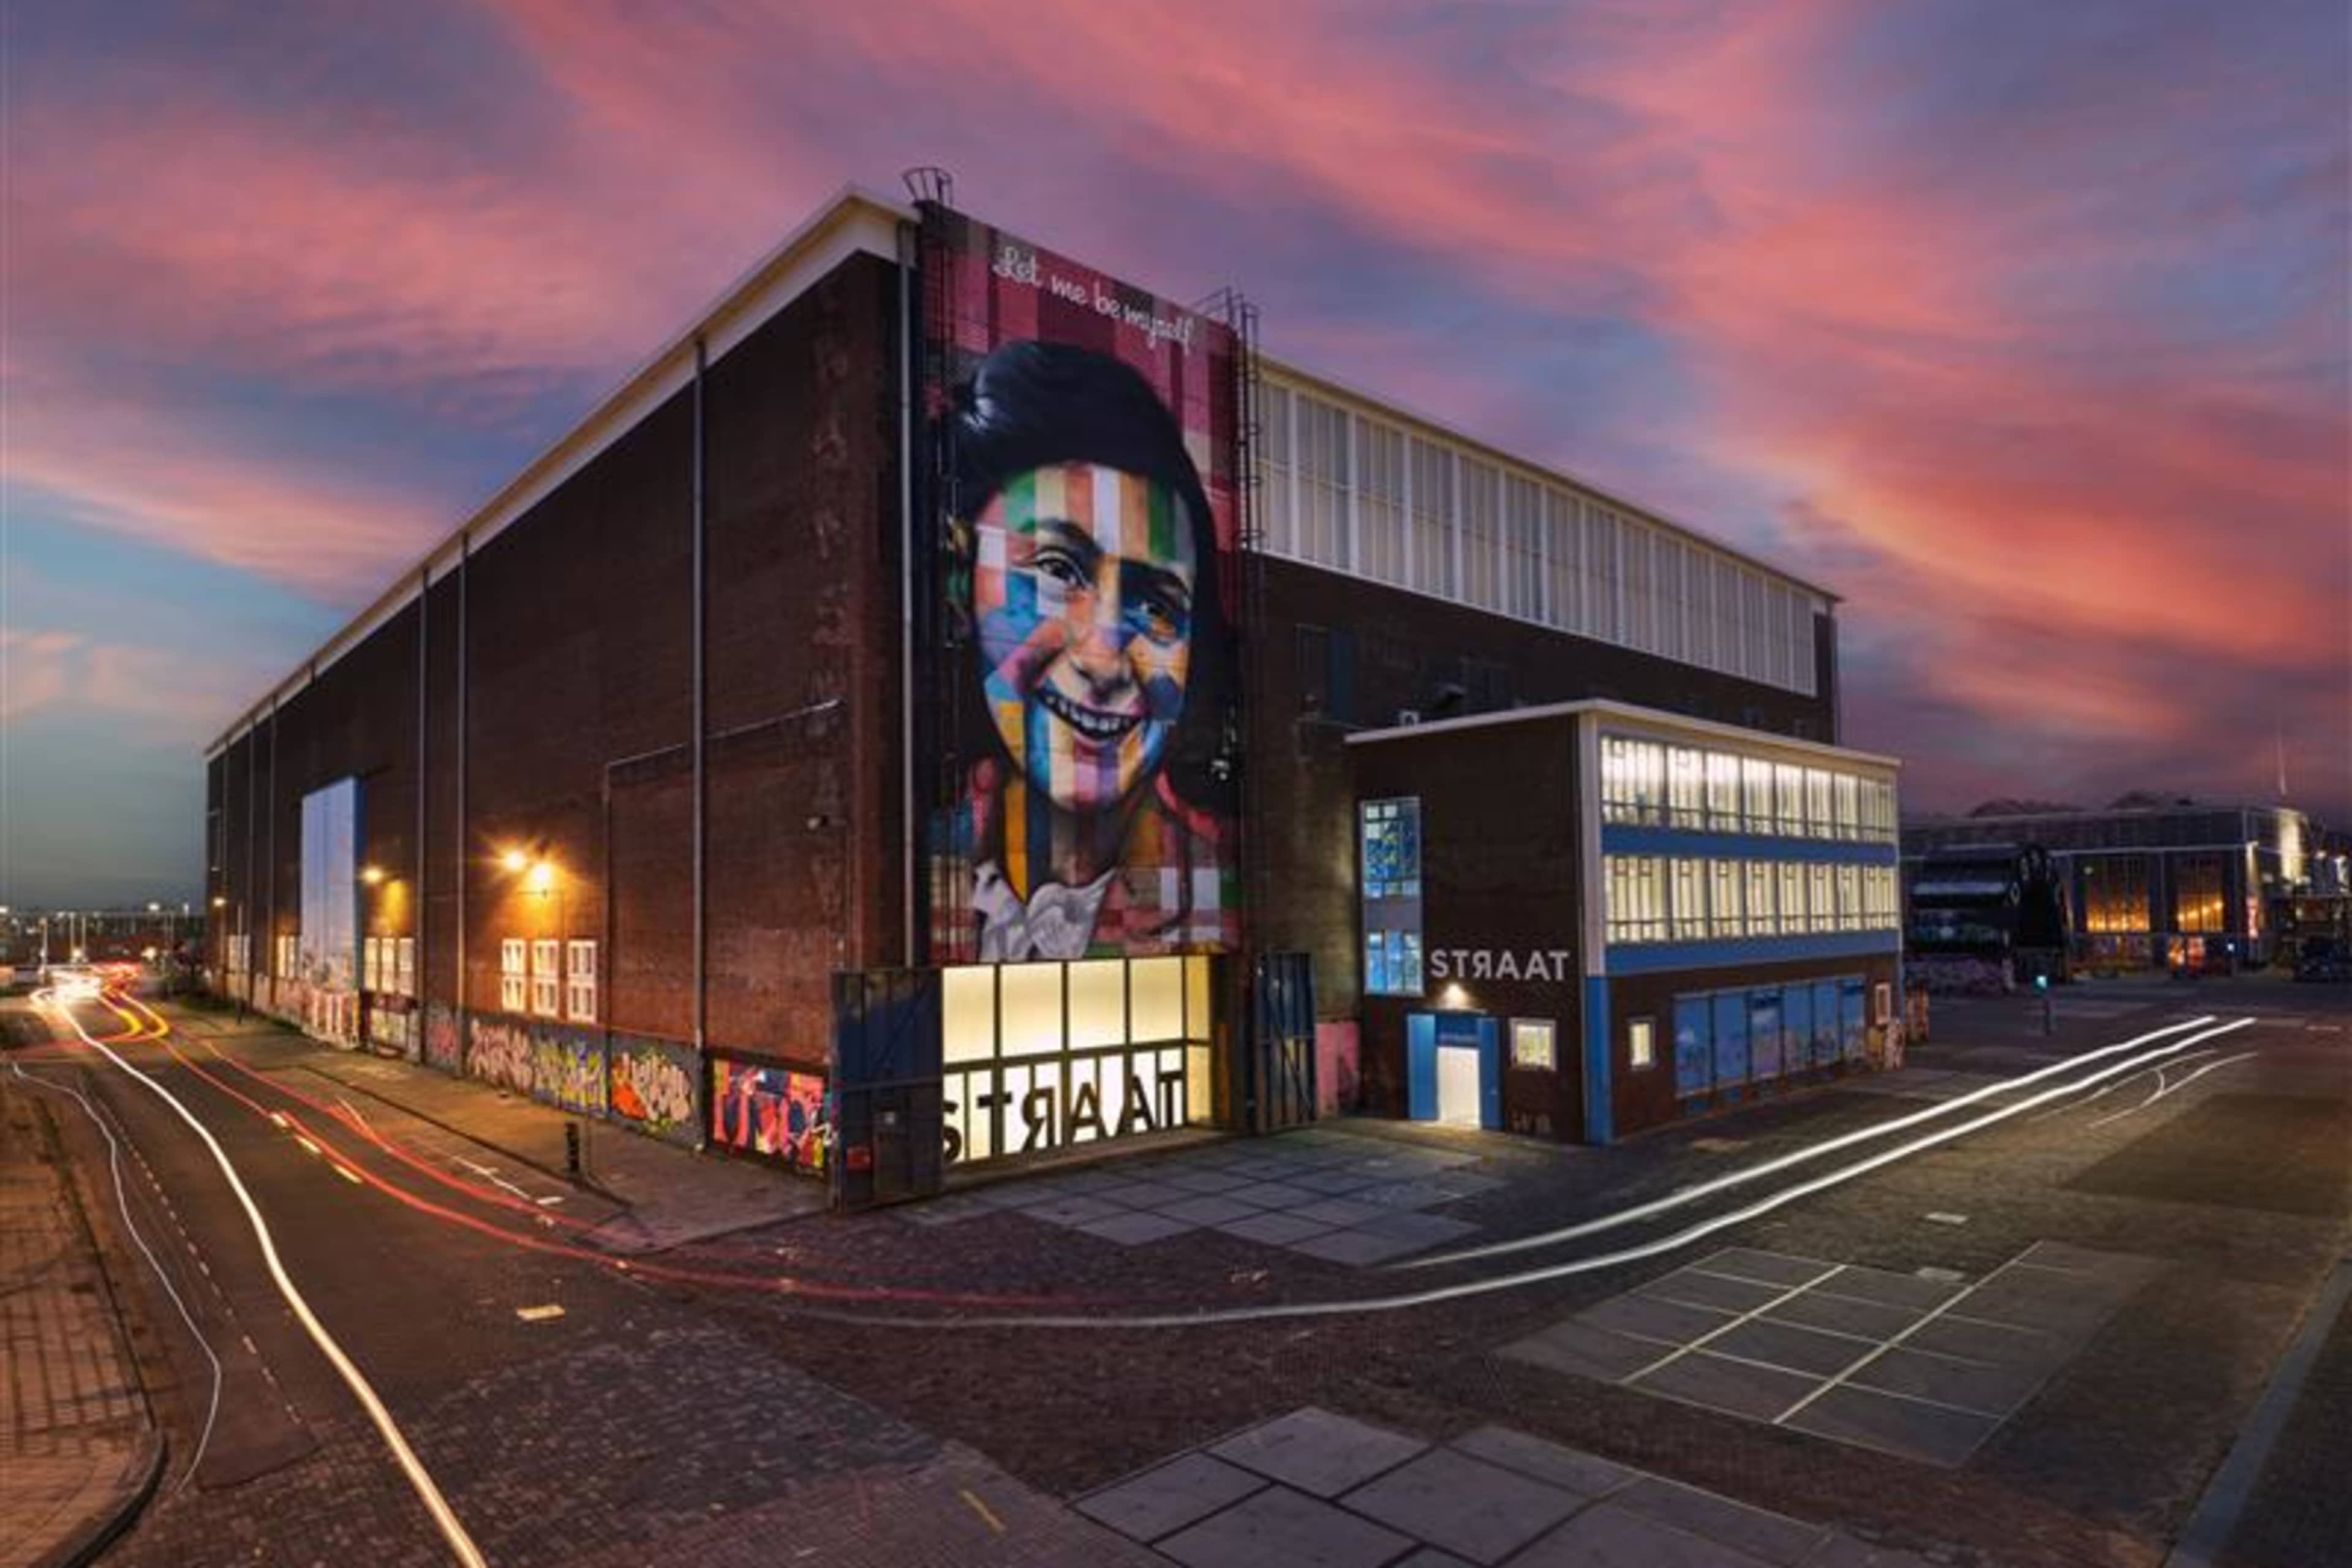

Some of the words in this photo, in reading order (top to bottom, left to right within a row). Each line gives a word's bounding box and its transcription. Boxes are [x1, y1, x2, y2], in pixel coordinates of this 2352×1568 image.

[992, 246, 1042, 287] Let
[1050, 274, 1088, 306] me
[1094, 279, 1121, 318] be
[1124, 306, 1195, 355] myself
[1430, 949, 1570, 981] STRAAT
